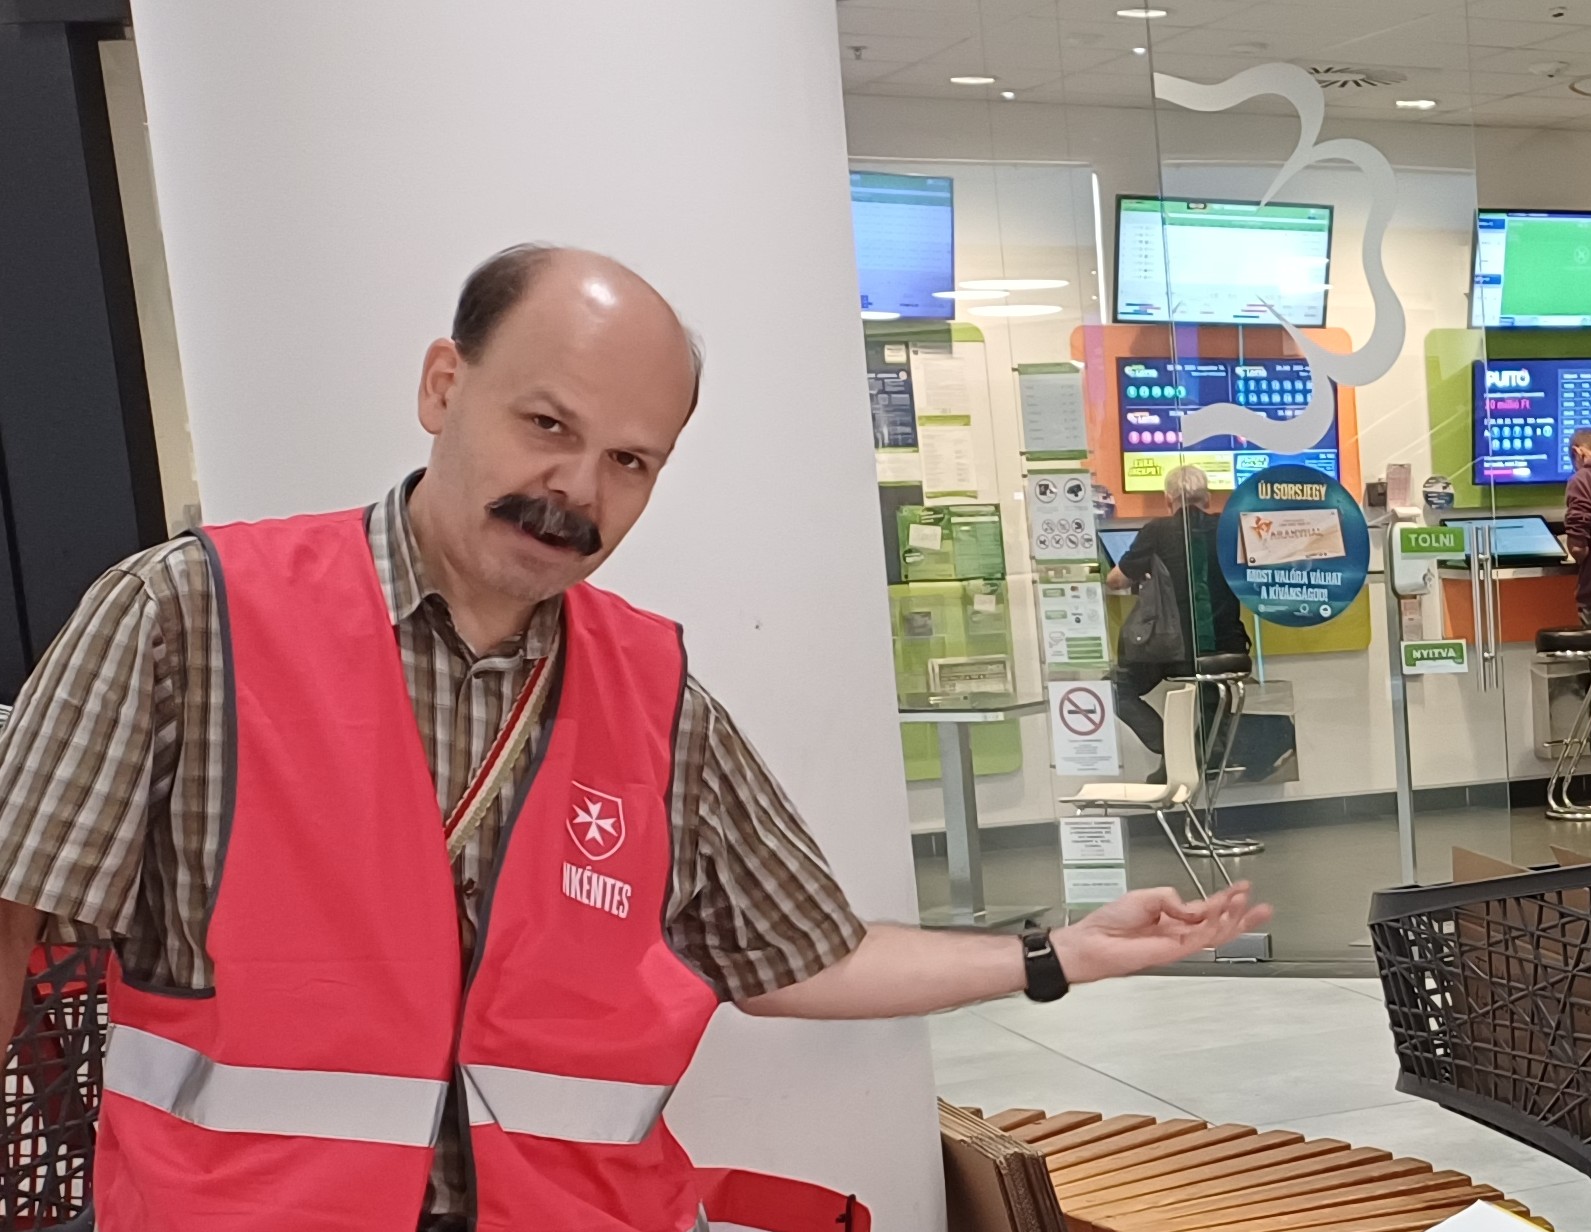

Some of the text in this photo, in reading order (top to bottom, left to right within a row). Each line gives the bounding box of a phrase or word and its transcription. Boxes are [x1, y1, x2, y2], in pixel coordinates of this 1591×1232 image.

[1258, 481, 1328, 501] ÚJ SORSJEGY
[1408, 533, 1455, 548] TOLNI
[1412, 647, 1457, 660] NYITVA
[562, 861, 632, 919] NKÉNTES
